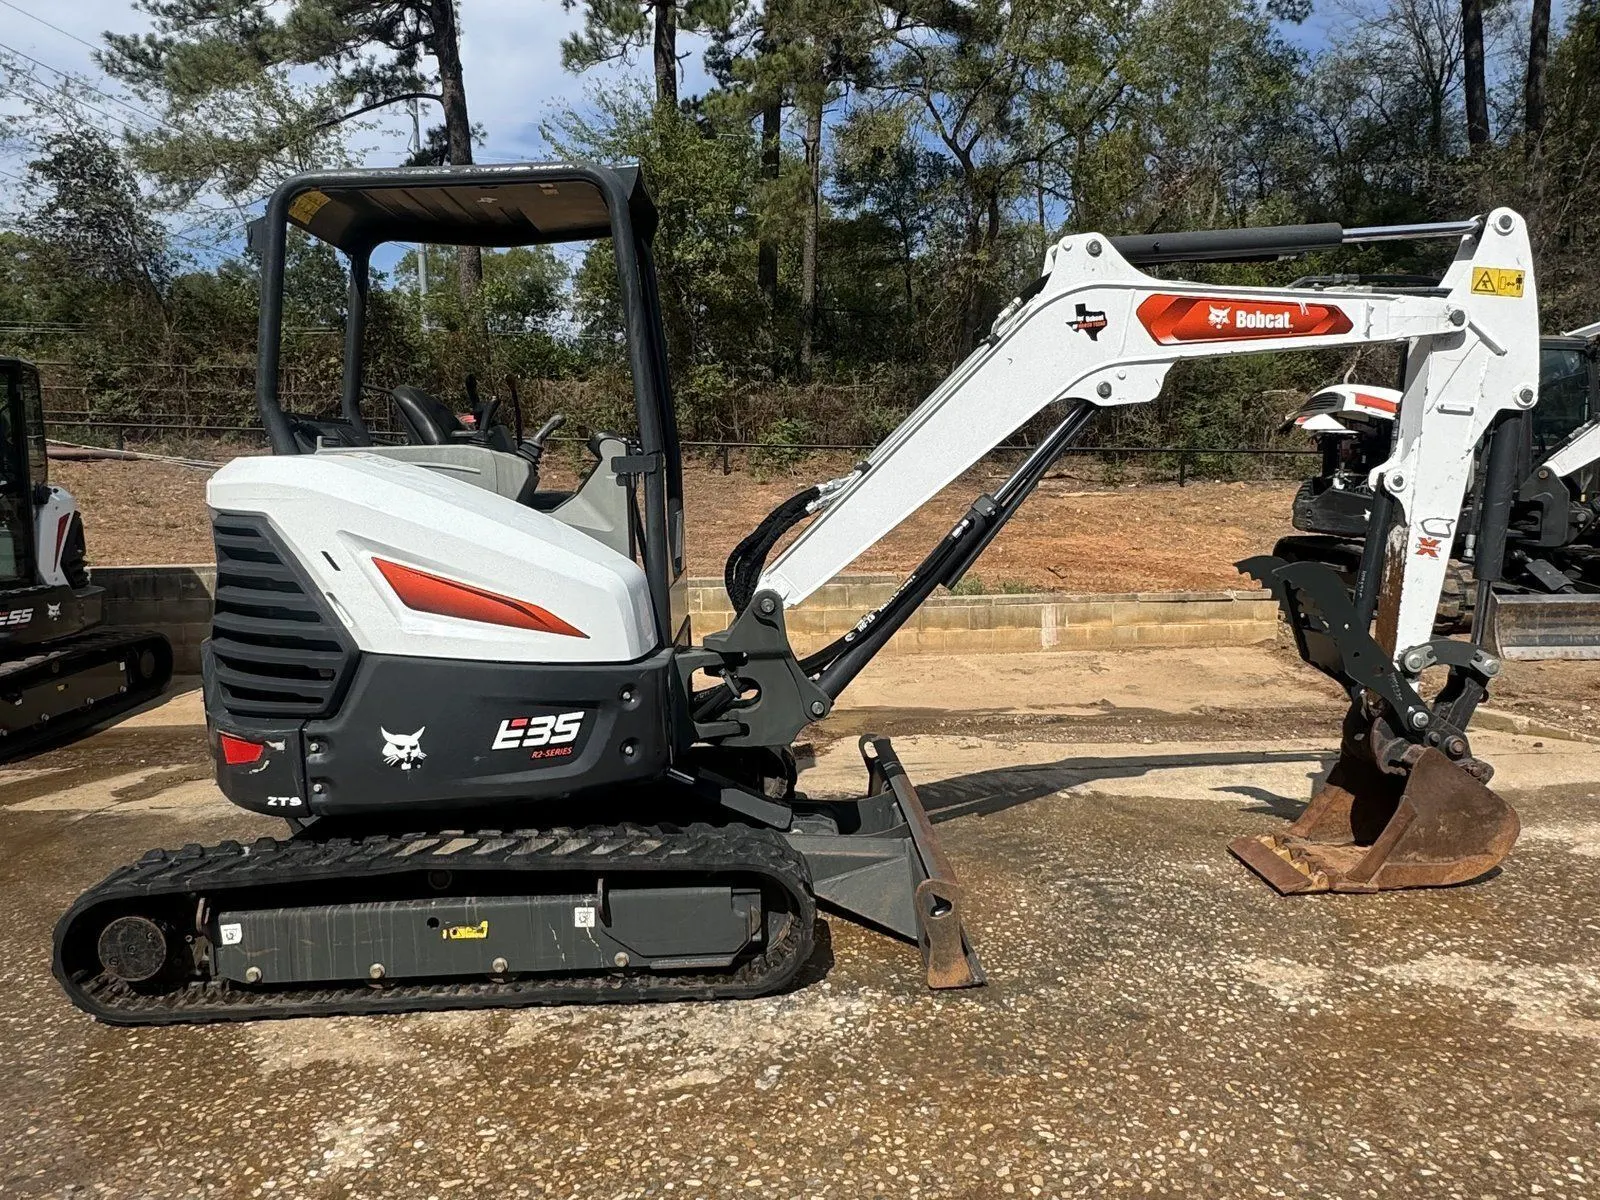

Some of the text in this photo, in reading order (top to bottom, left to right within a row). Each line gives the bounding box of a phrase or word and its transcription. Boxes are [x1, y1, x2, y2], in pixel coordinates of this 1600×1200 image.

[1235, 310, 1293, 329] Bobcat
[491, 711, 585, 750] E35
[531, 747, 573, 759] R2-SERIES
[267, 796, 302, 807] ZTS
